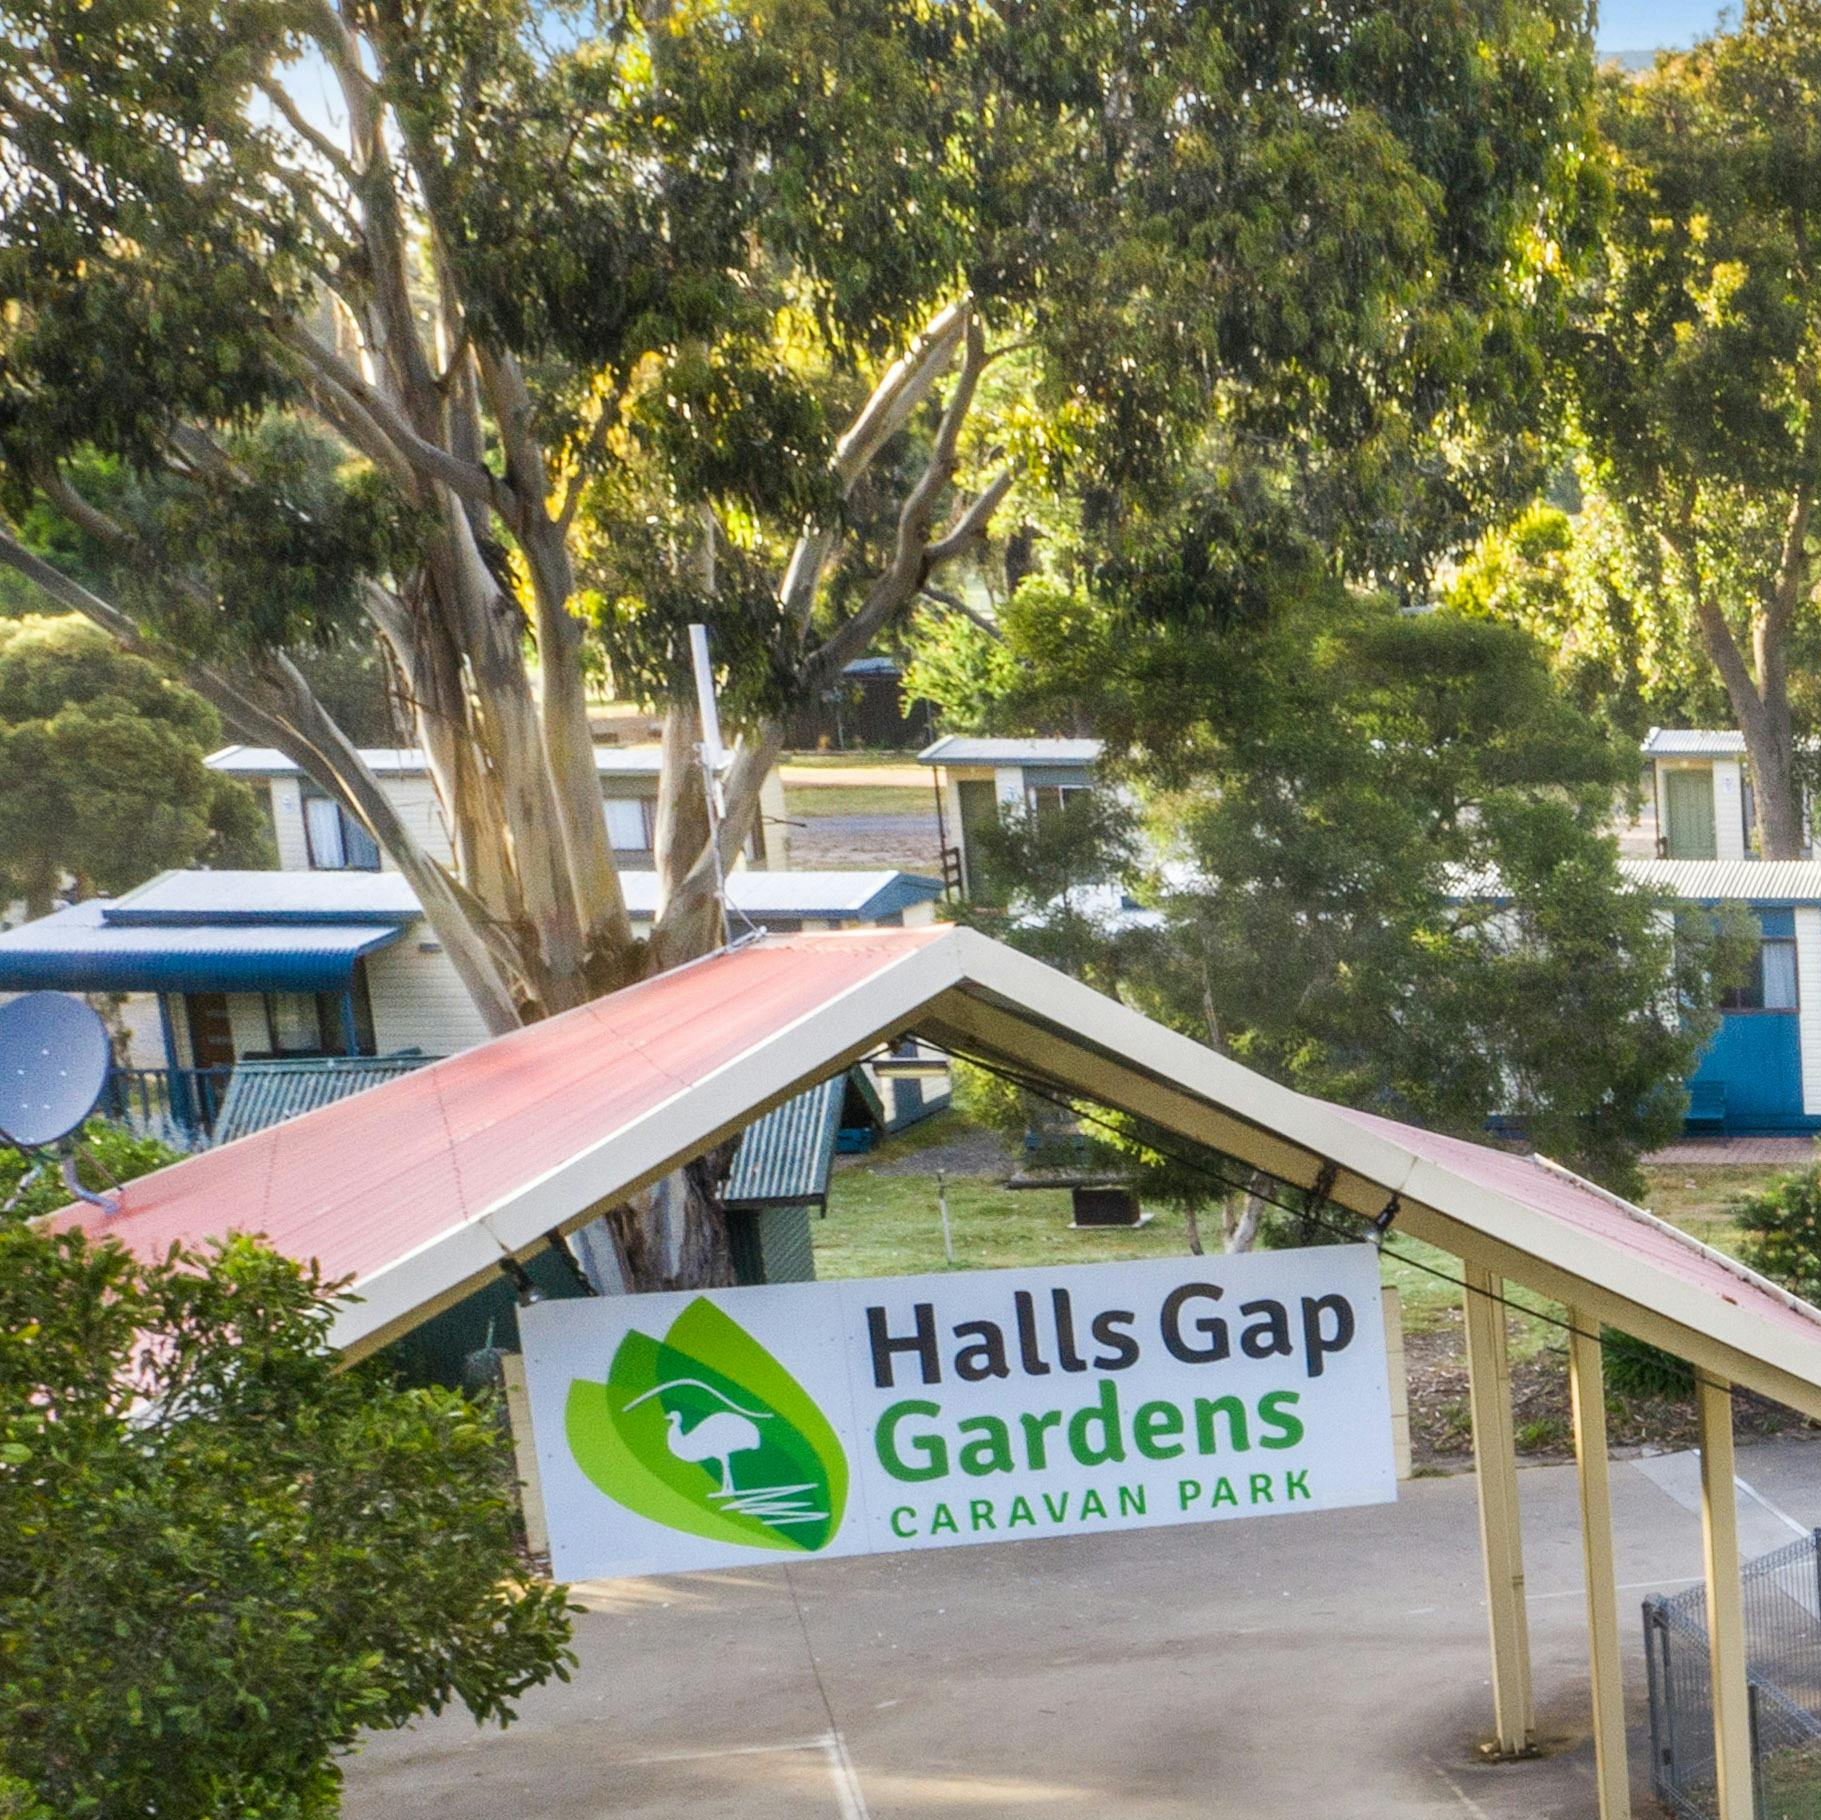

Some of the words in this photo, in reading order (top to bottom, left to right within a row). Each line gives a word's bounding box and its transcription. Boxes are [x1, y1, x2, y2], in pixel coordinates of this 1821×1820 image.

[864, 1286, 1140, 1390] Halls
[1159, 1282, 1356, 1379] Gap
[873, 1378, 1305, 1484] Gardens
[889, 1483, 1147, 1539] CARAVAN
[1177, 1469, 1312, 1512] PARK
